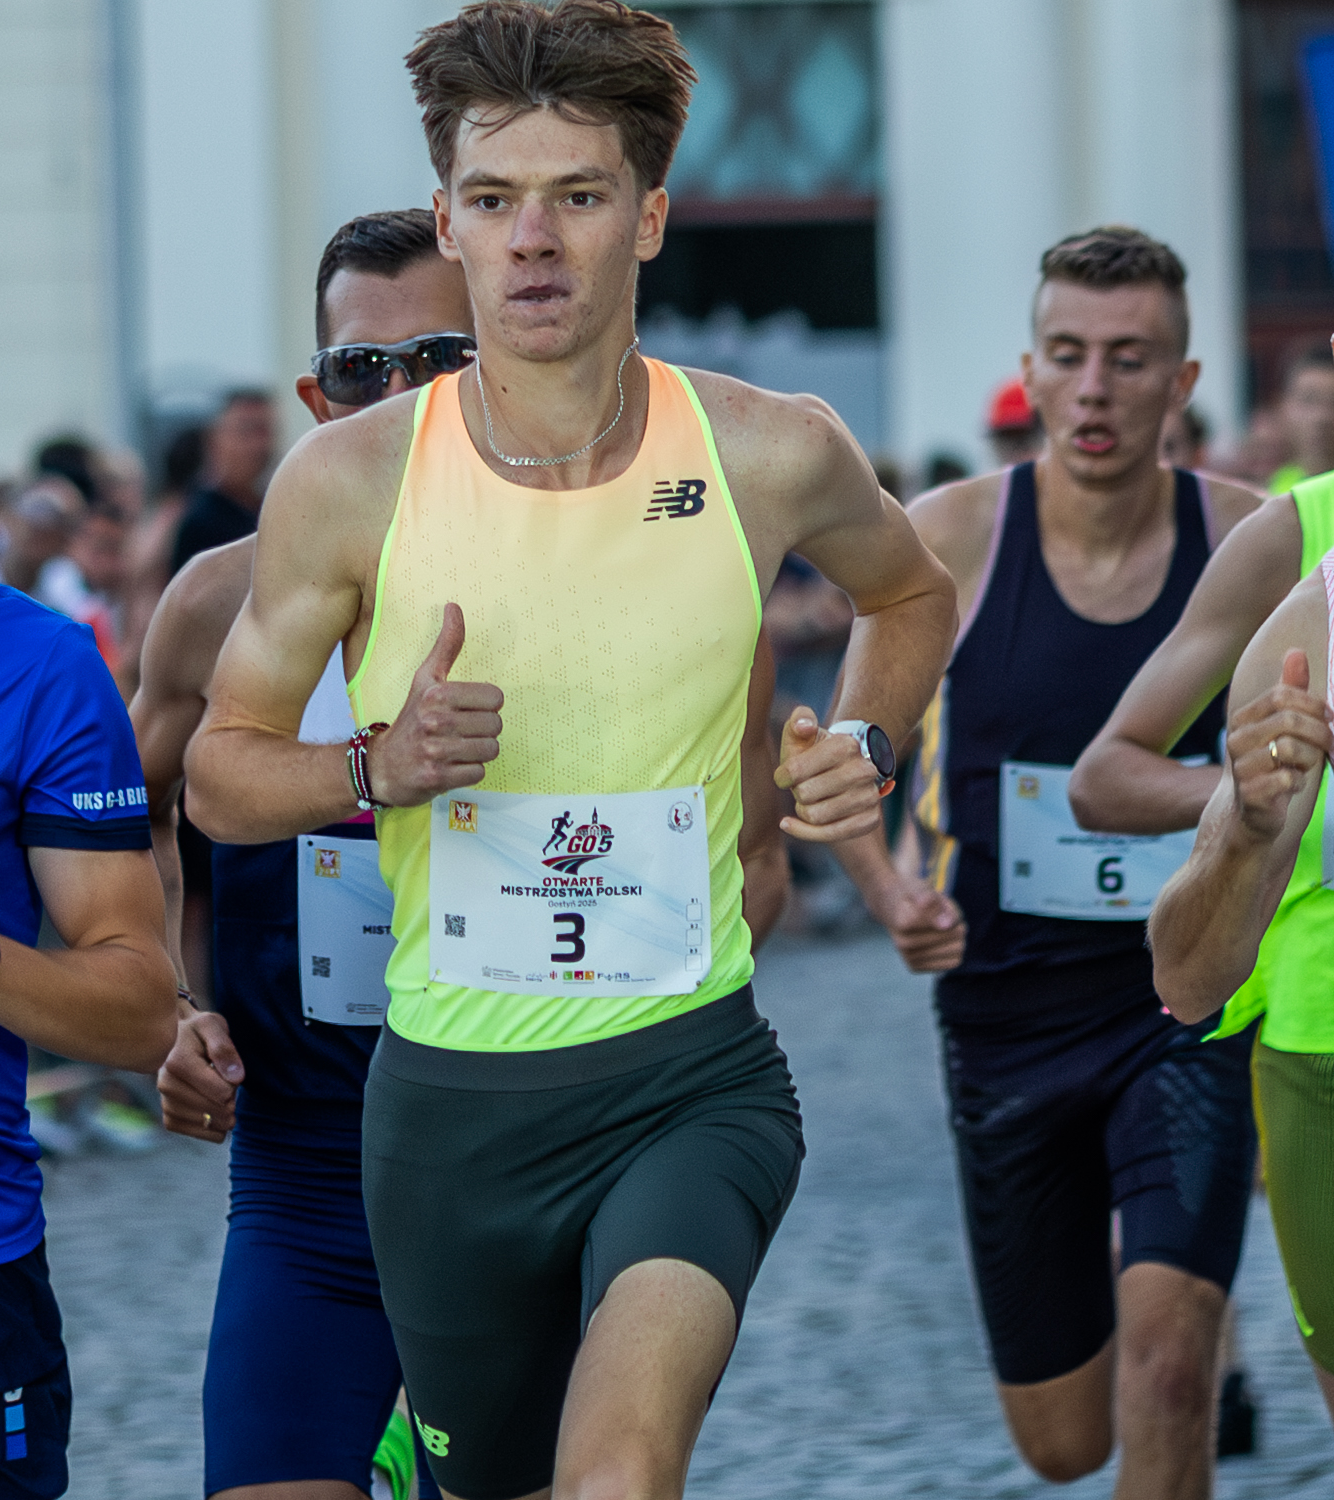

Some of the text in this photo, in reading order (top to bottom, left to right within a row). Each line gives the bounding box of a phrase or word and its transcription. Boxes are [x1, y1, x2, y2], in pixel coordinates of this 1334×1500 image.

[72, 792, 103, 810] UKS
[543, 876, 604, 887] OTWARTE
[1097, 857, 1123, 893] 6
[501, 885, 642, 898] MISTRZOSTWA POLSKI
[551, 912, 585, 963] 3
